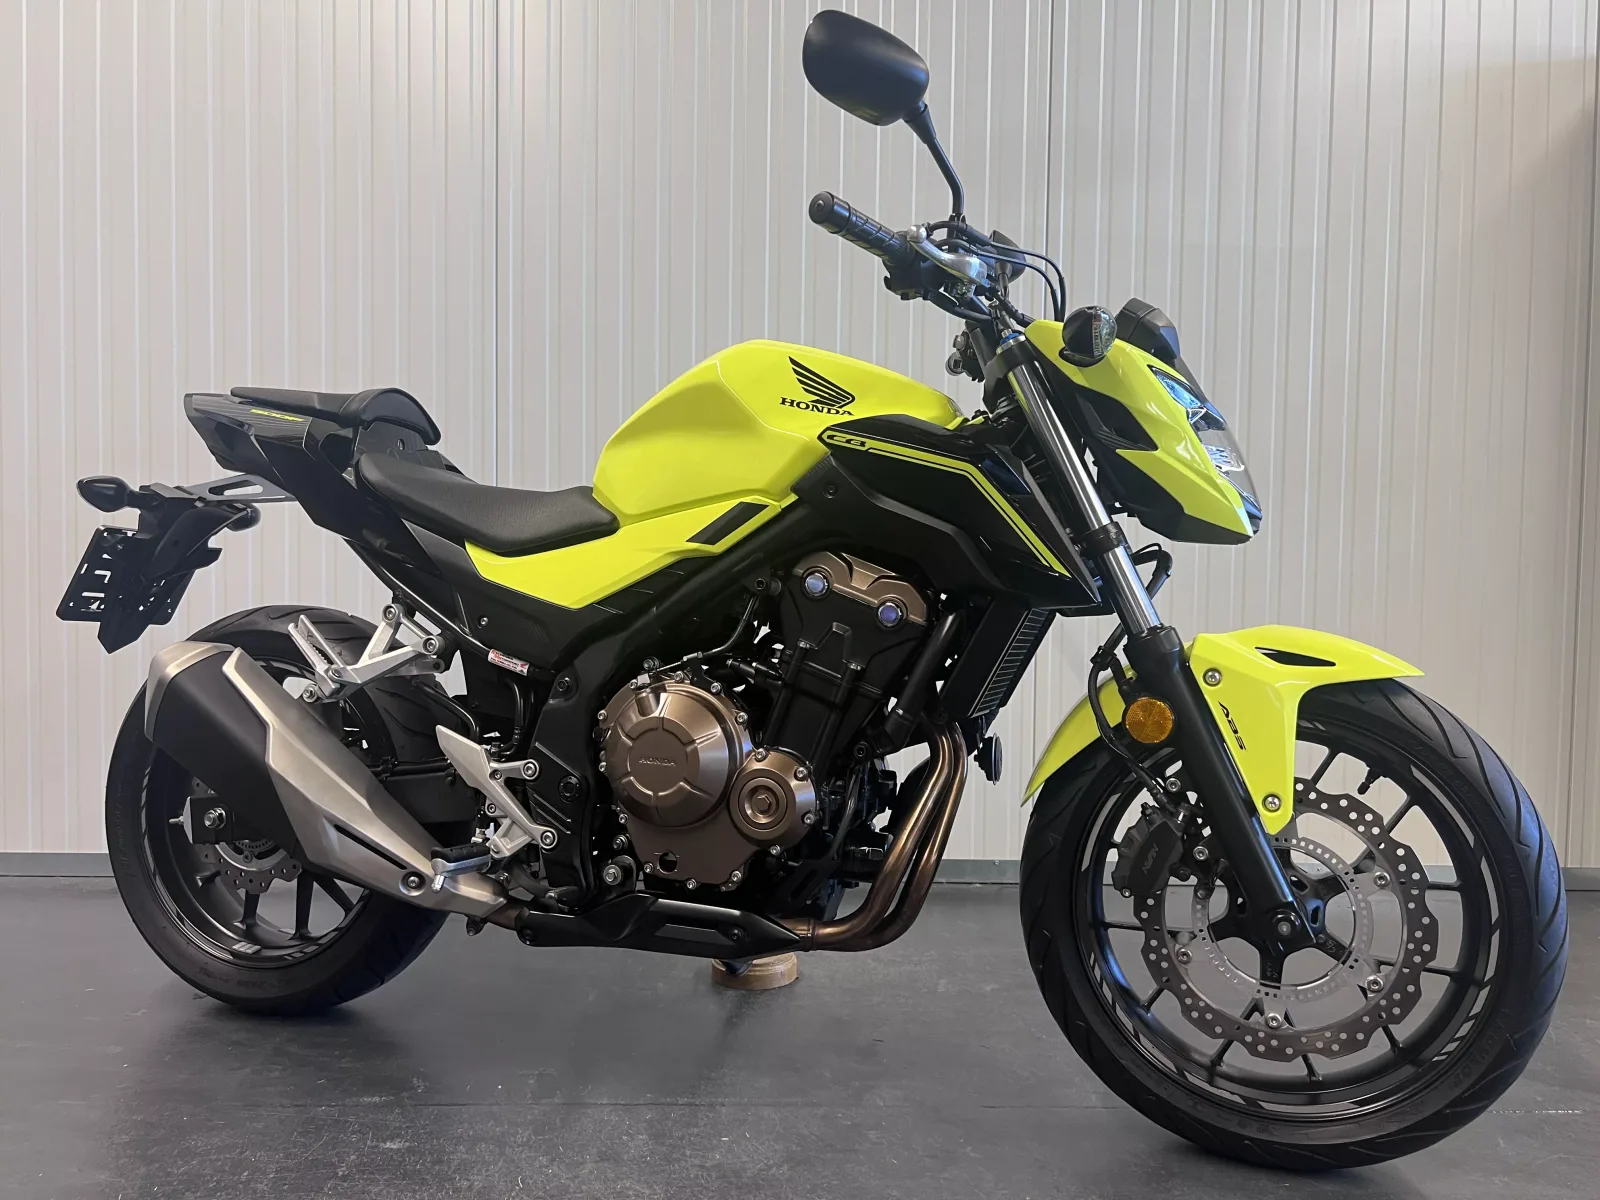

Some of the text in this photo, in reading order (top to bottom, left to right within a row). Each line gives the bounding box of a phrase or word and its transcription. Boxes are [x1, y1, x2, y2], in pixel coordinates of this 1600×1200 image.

[779, 396, 855, 417] HONDA
[826, 434, 867, 448] CB
[1217, 700, 1247, 751] ABS
[638, 756, 677, 767] HONDA
